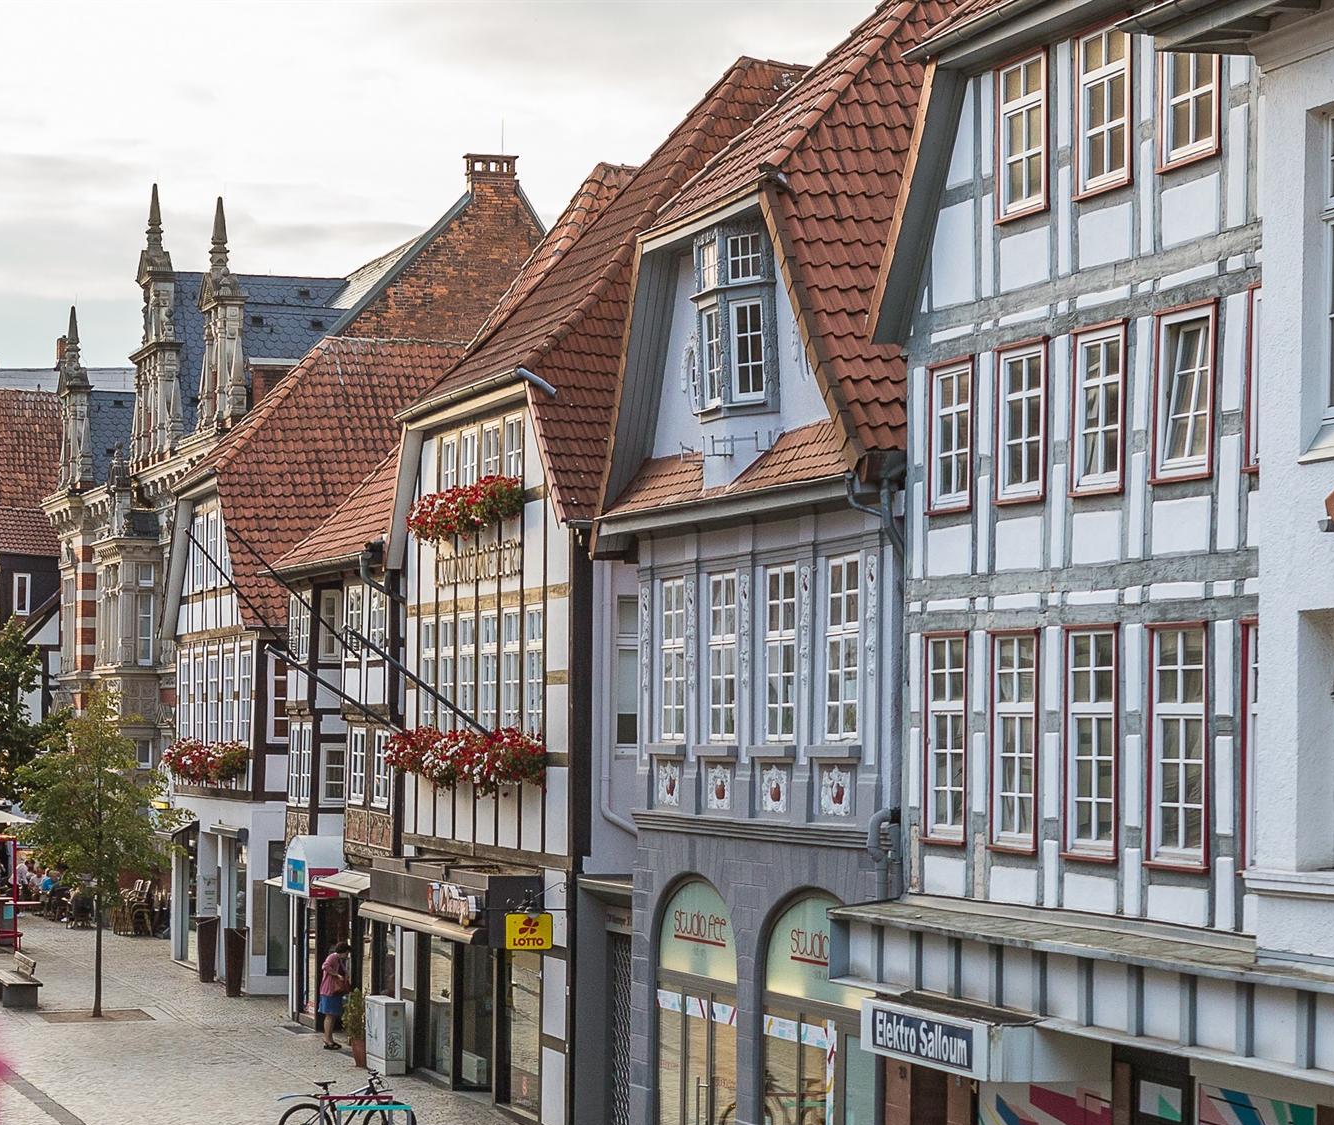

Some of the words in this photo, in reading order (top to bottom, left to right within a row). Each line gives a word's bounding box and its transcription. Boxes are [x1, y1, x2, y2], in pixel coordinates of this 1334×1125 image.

[512, 937, 545, 947] LOTTO
[674, 908, 707, 938] studio
[708, 917, 727, 942] fee
[875, 1011, 917, 1054] Elektro
[919, 1021, 968, 1066] Salloum
